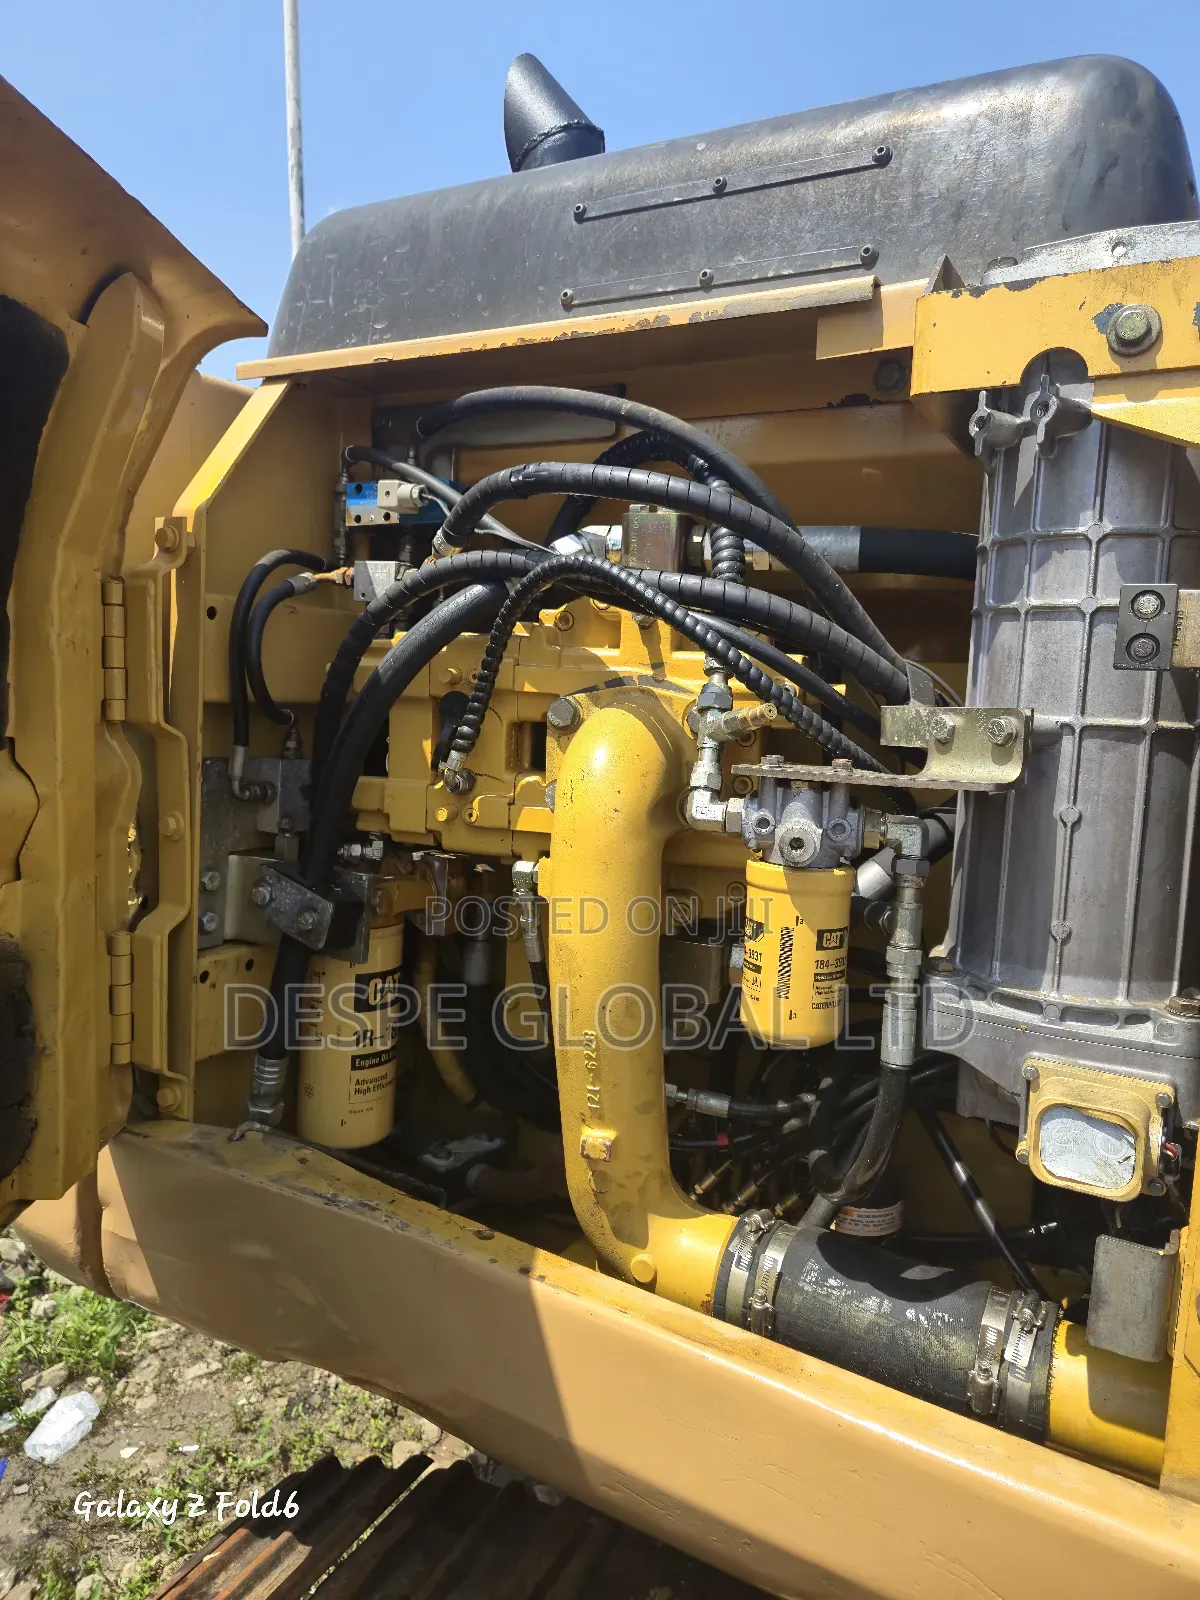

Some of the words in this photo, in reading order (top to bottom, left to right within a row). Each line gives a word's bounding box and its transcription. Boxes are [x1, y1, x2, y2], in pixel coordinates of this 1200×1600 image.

[823, 931, 841, 948] CAT
[368, 972, 401, 1006] CAT
[355, 1057, 380, 1067] Engine
[354, 1072, 388, 1087] Advanced
[354, 1087, 371, 1096] High
